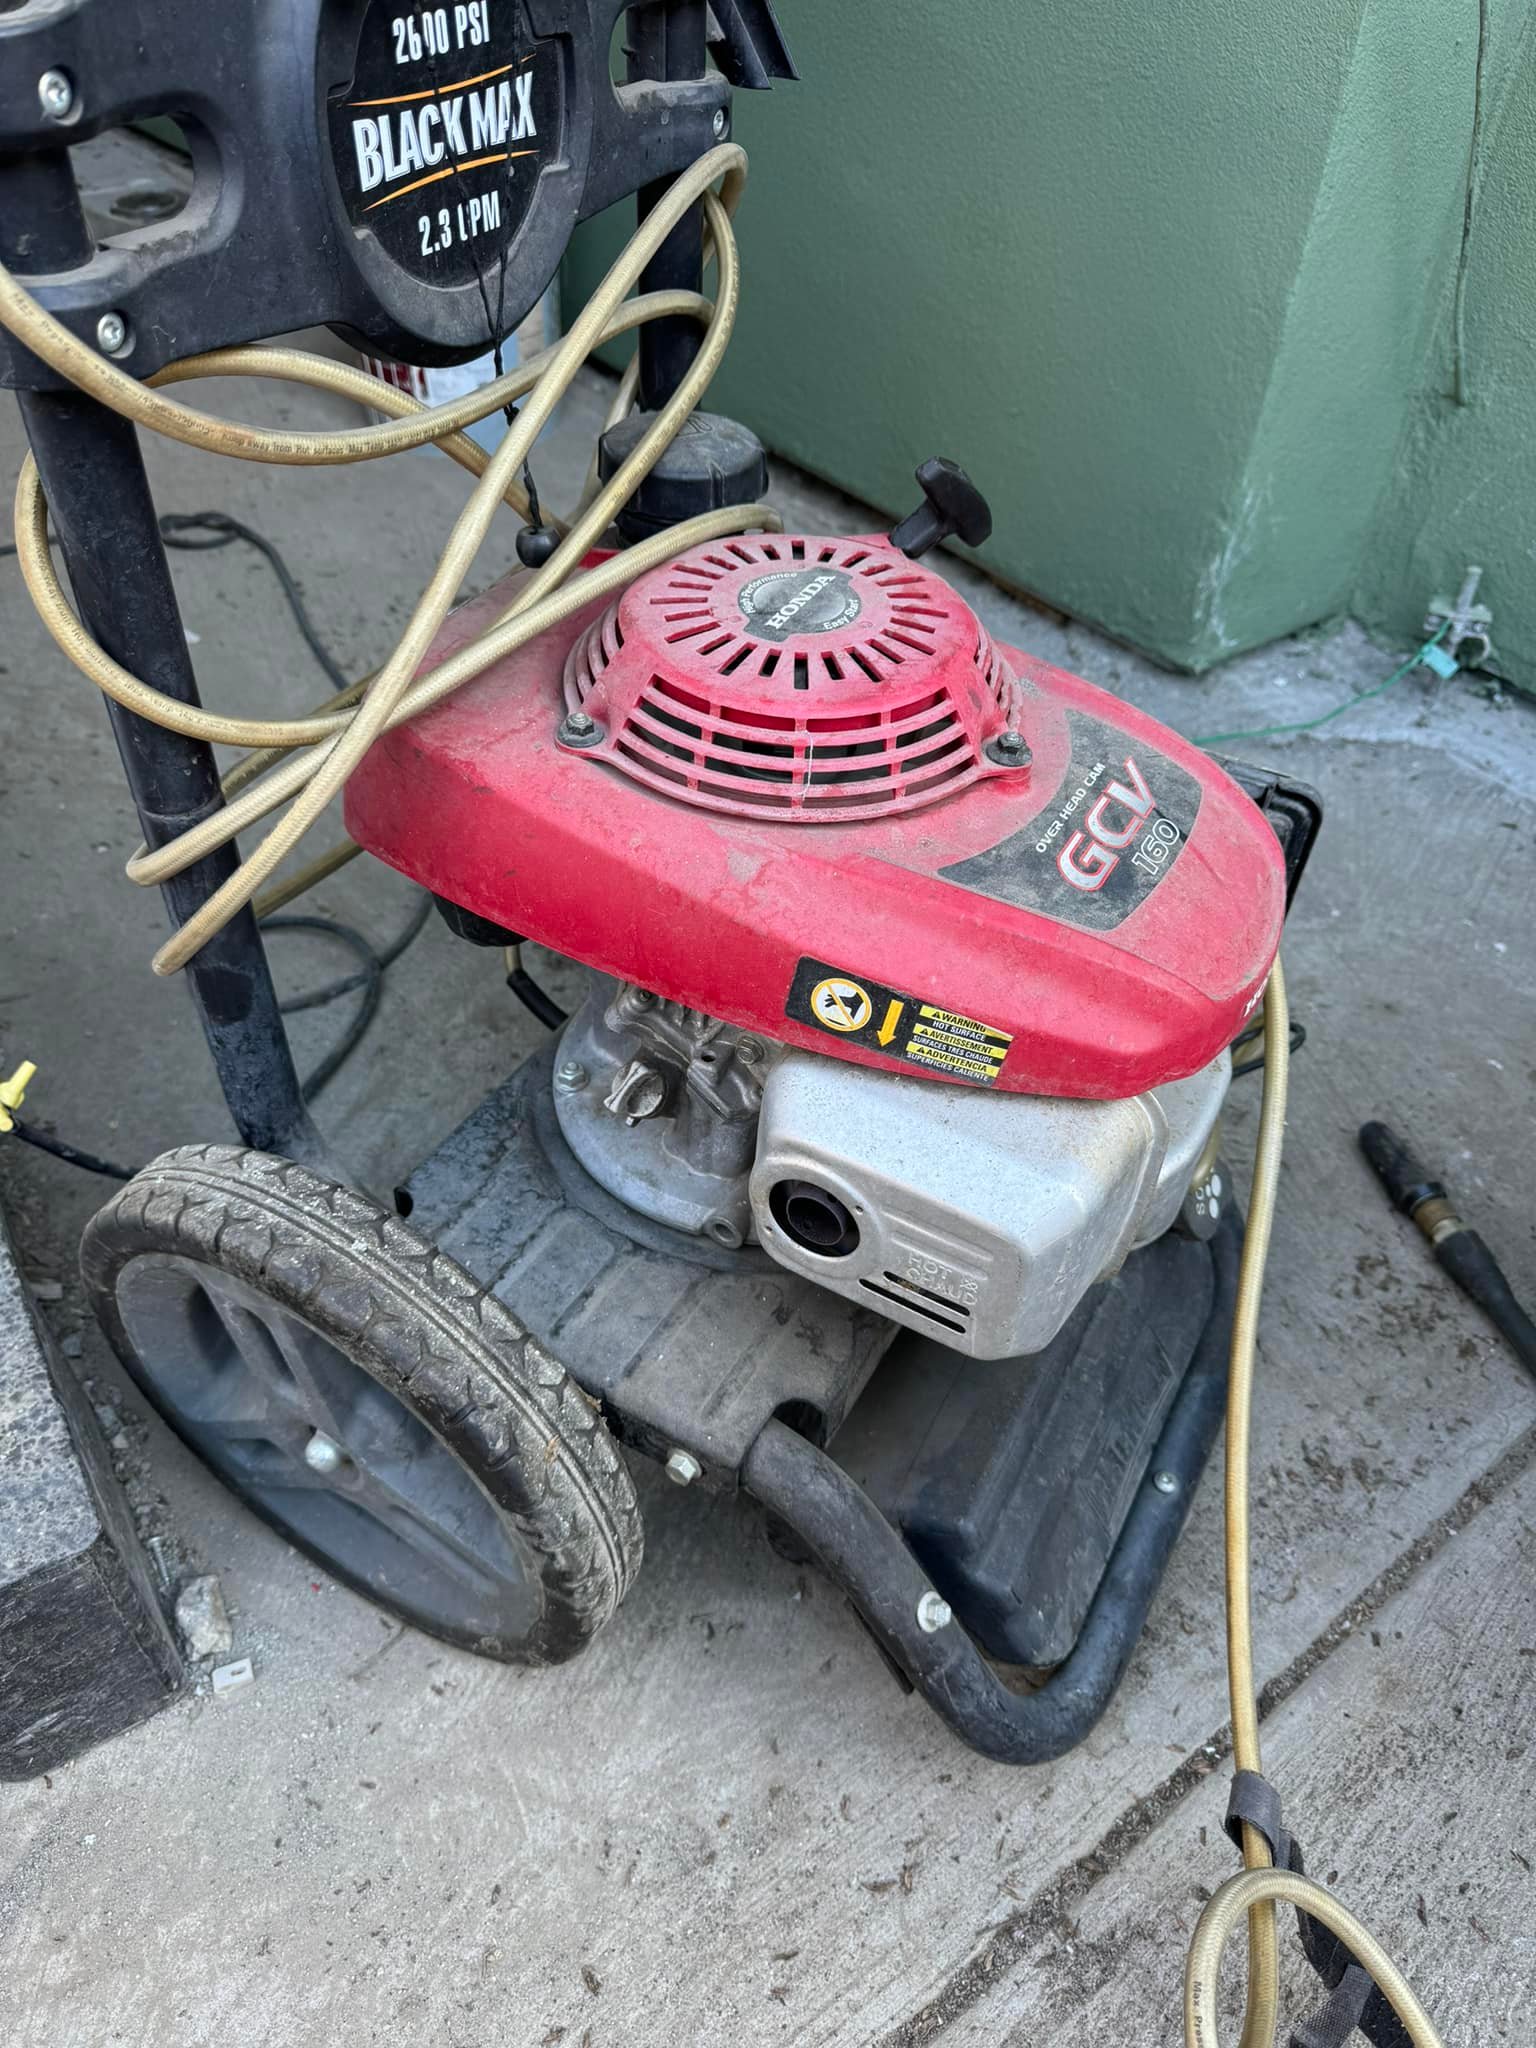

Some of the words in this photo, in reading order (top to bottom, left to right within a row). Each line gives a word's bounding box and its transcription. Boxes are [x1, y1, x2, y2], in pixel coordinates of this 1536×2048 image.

[392, 8, 449, 64] 2600
[454, 0, 490, 49] PSI
[352, 96, 468, 192] BLACK
[468, 71, 537, 150] MAX
[418, 208, 453, 256] 2.3
[765, 574, 836, 629] HONDA
[823, 615, 850, 630] Easy
[1035, 819, 1064, 853] OVER
[1059, 788, 1087, 822] HEAD
[1084, 762, 1106, 787] CAM
[1055, 756, 1156, 892] GCV
[1131, 817, 1181, 876] 160
[932, 1020, 949, 1031] HOT
[950, 1025, 986, 1042] SURFACE
[941, 1012, 986, 1033] WARNING
[912, 1034, 946, 1051] SURFACES
[930, 1030, 993, 1055] AVERTISSEMENT
[906, 1052, 954, 1072] SUPERFICIES
[953, 1064, 988, 1082] CALIENTE
[927, 1049, 987, 1072] ADVERTENCIA
[1192, 1981, 1202, 2007] Max
